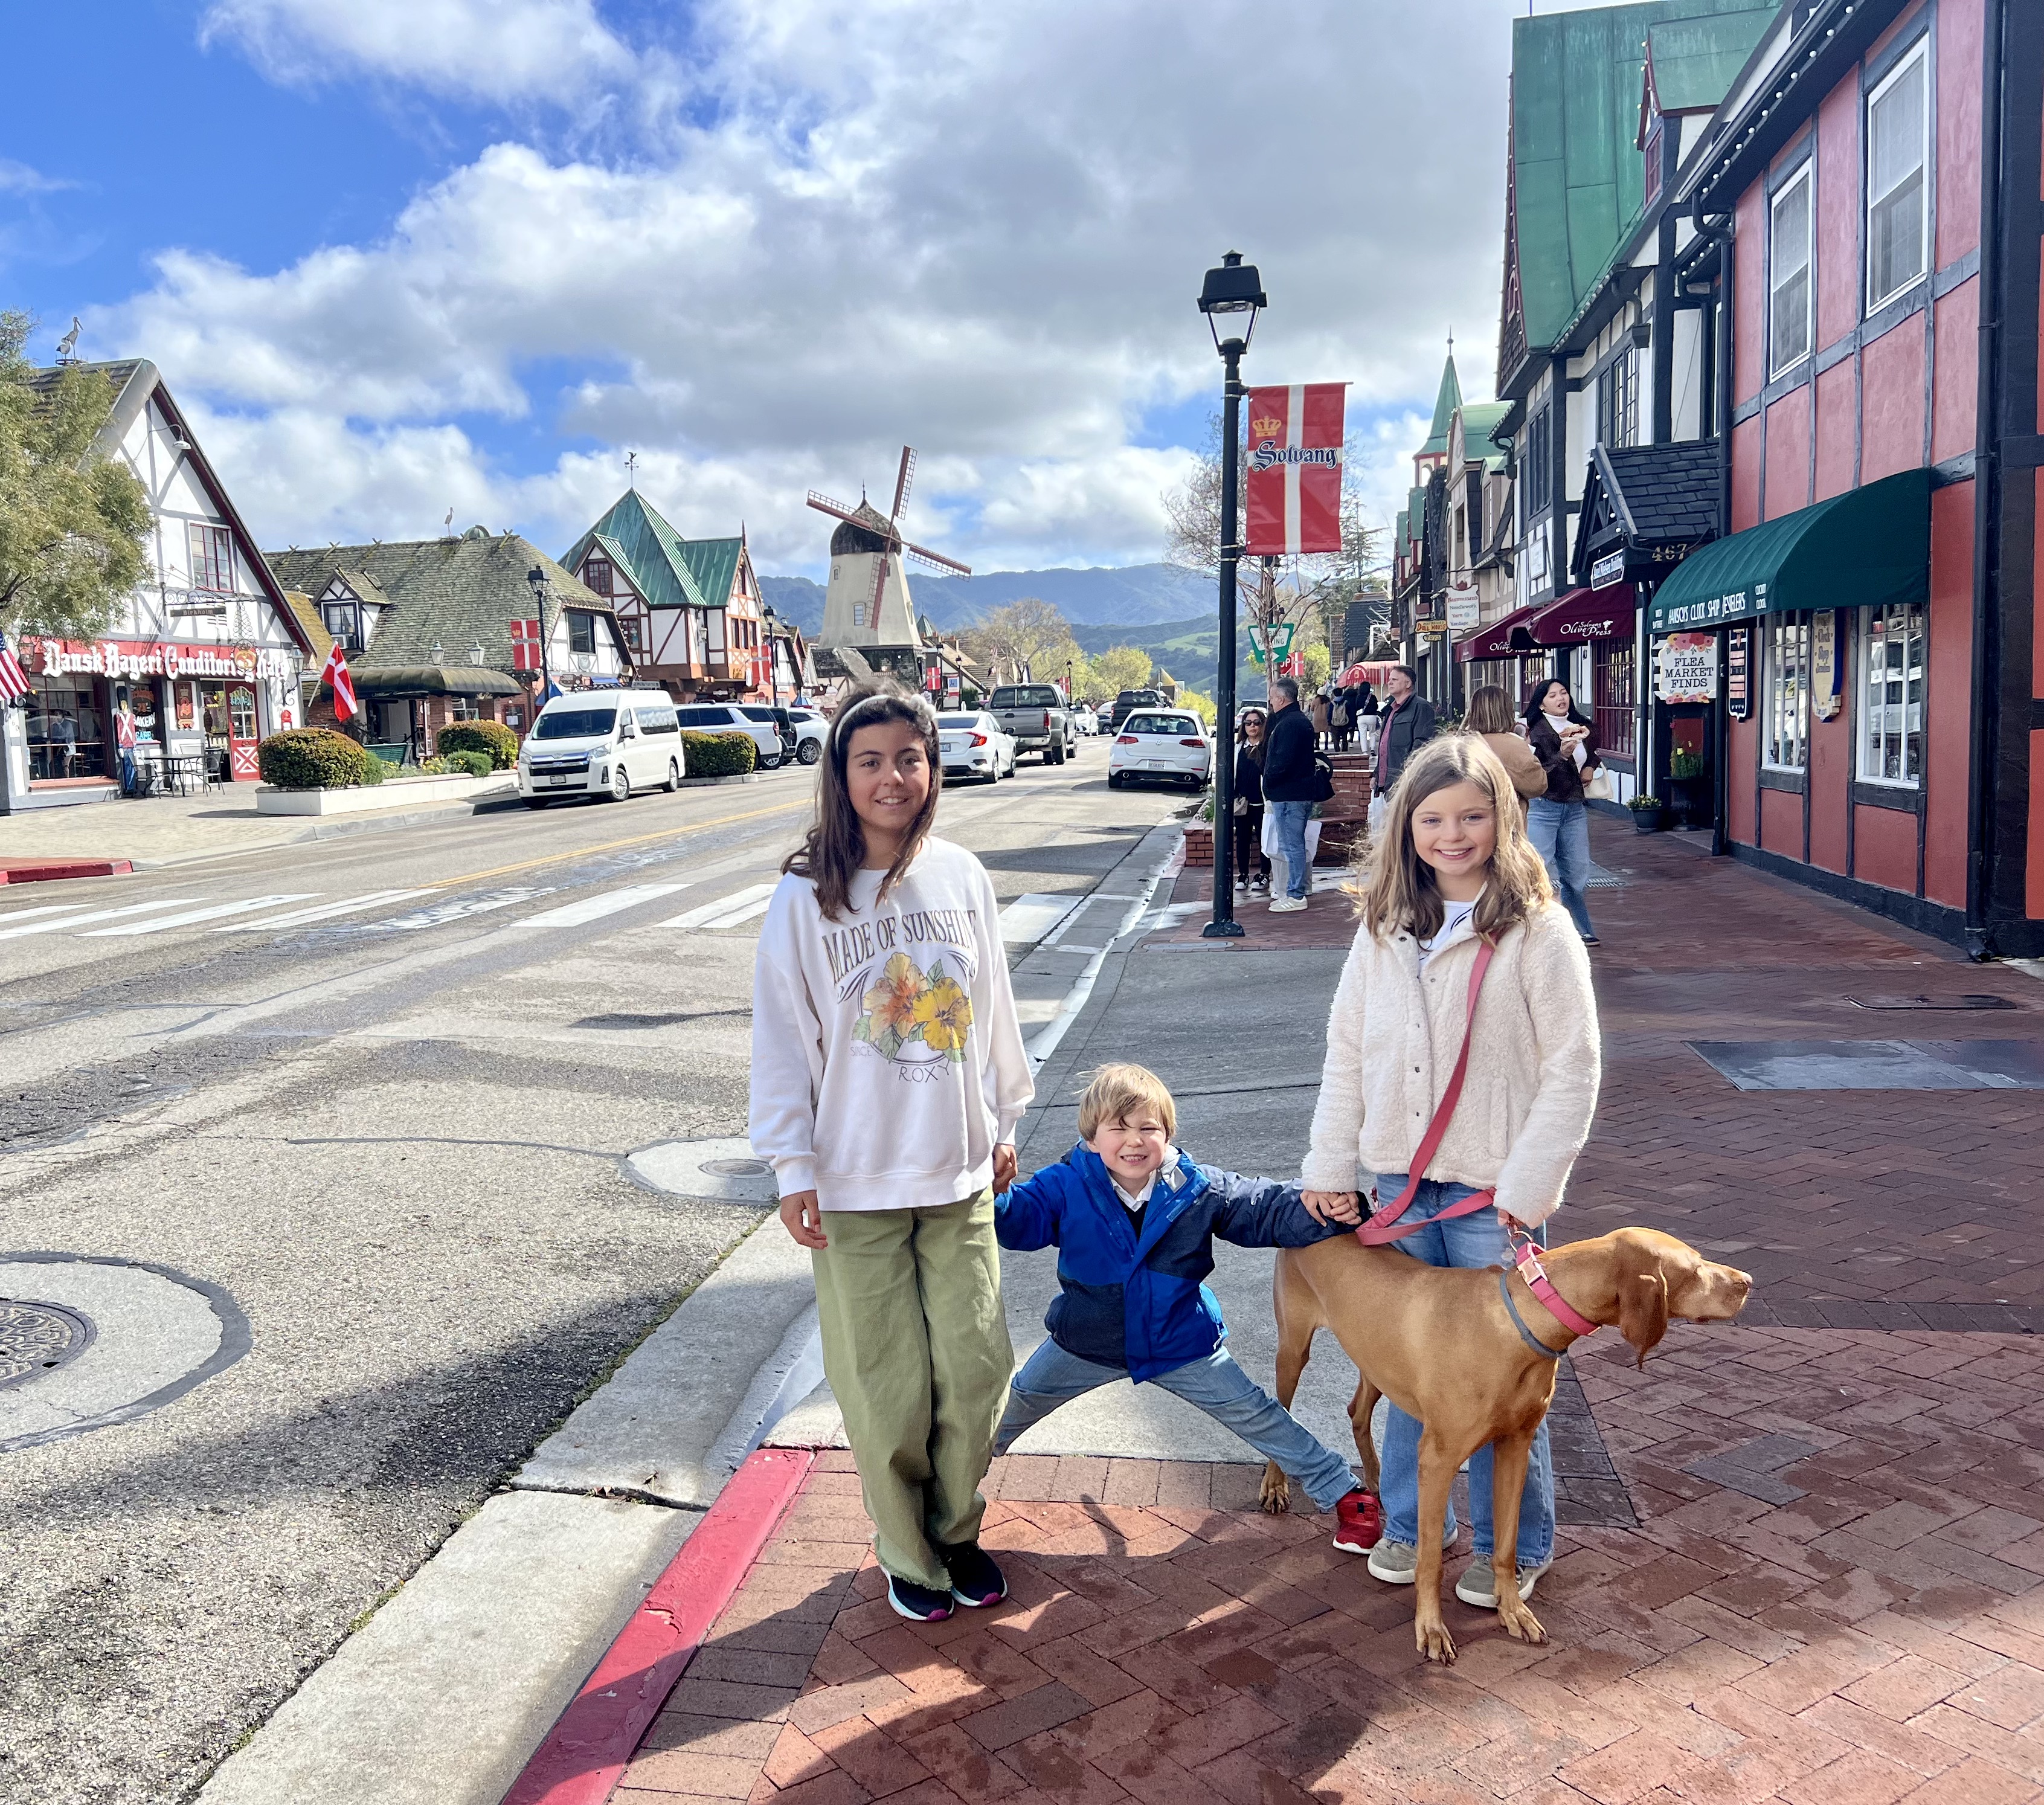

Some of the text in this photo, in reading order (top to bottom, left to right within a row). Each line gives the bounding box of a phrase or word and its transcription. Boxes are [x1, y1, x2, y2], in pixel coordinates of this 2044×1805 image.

[1252, 440, 1338, 472] Solvang
[1652, 544, 1688, 562] 467
[1560, 622, 1612, 637] Olive Press
[103, 642, 163, 680] Bageri
[1674, 657, 1705, 667] FLEA
[1665, 667, 1714, 678] MARKET
[1671, 678, 1708, 688] FINDS
[821, 909, 979, 987] MADE OF SUNSHINE
[850, 1046, 872, 1057] SINCE
[898, 1060, 950, 1083] ROXY
